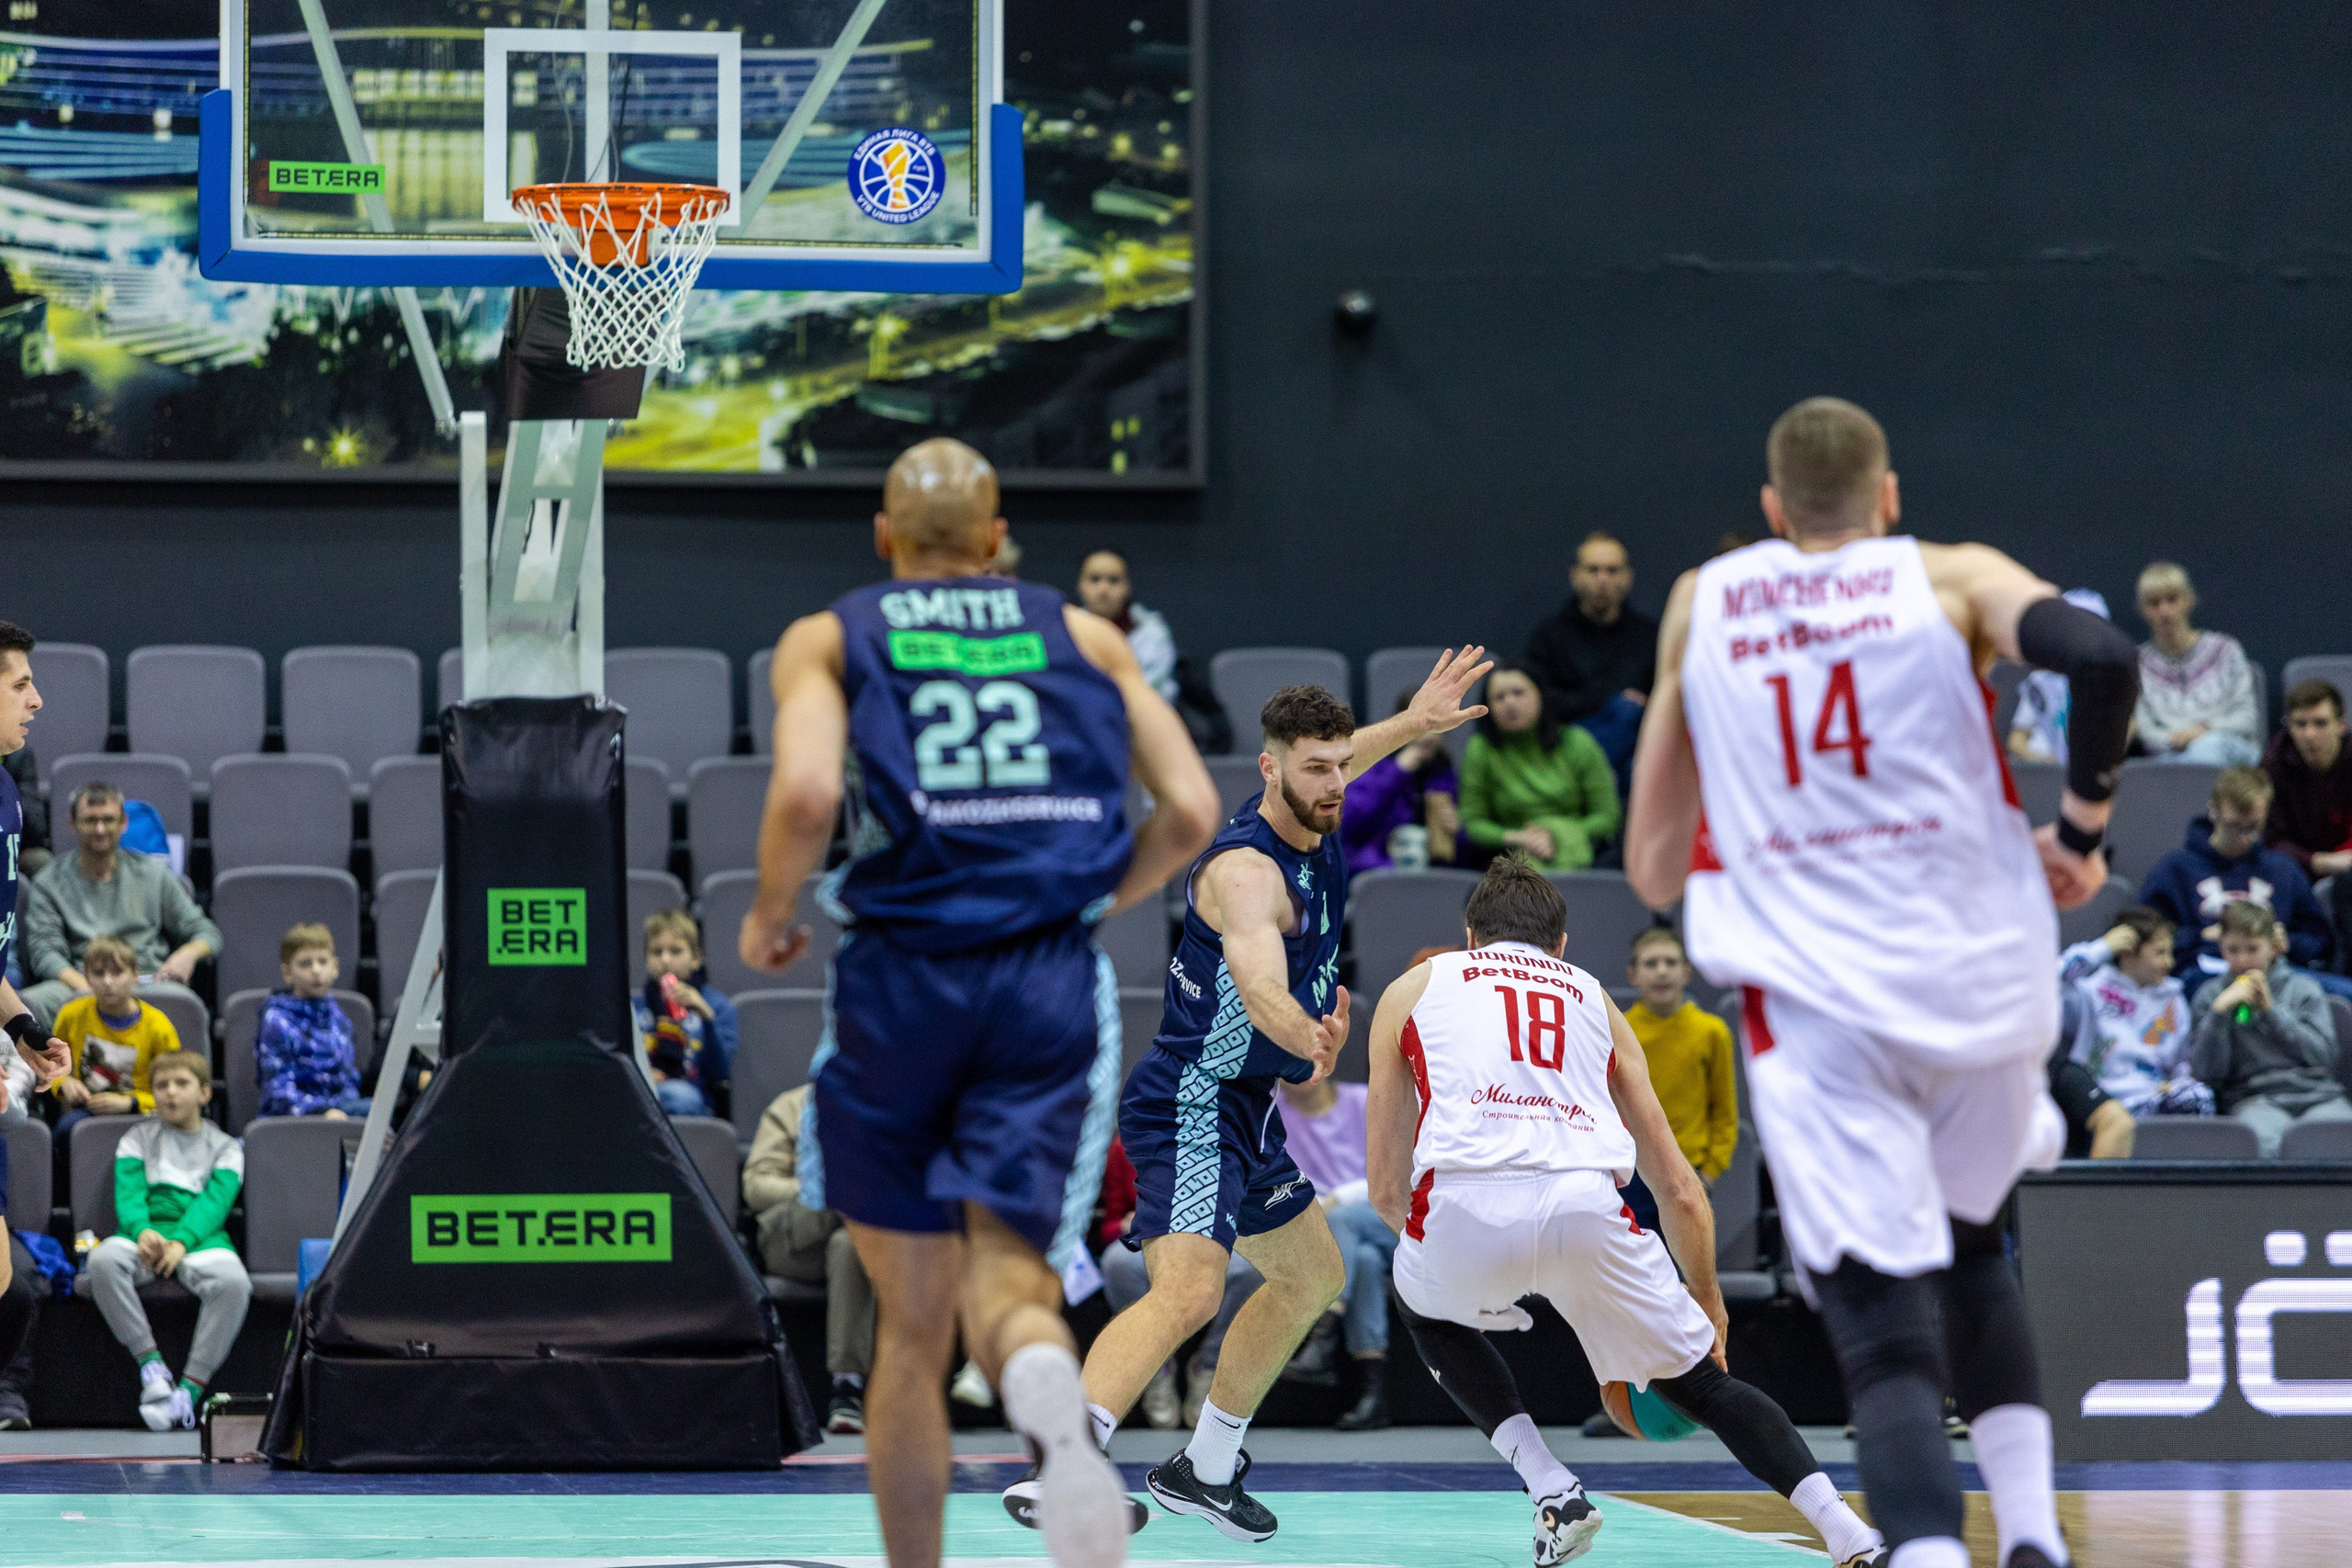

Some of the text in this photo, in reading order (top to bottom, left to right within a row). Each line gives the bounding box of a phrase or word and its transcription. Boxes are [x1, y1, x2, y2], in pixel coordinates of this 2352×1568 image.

[891, 129, 919, 142] ЛИГА
[919, 137, 936, 156] ВТБ
[856, 190, 940, 223] VTB UNITED LEAGUE
[879, 587, 1025, 631] SMITH
[910, 680, 1052, 791] 22
[1765, 658, 1871, 787] 14
[502, 899, 577, 924] BET
[1468, 952, 1573, 976] VORONOV
[1463, 966, 1584, 1004] BetBoom
[1494, 985, 1566, 1074] 18
